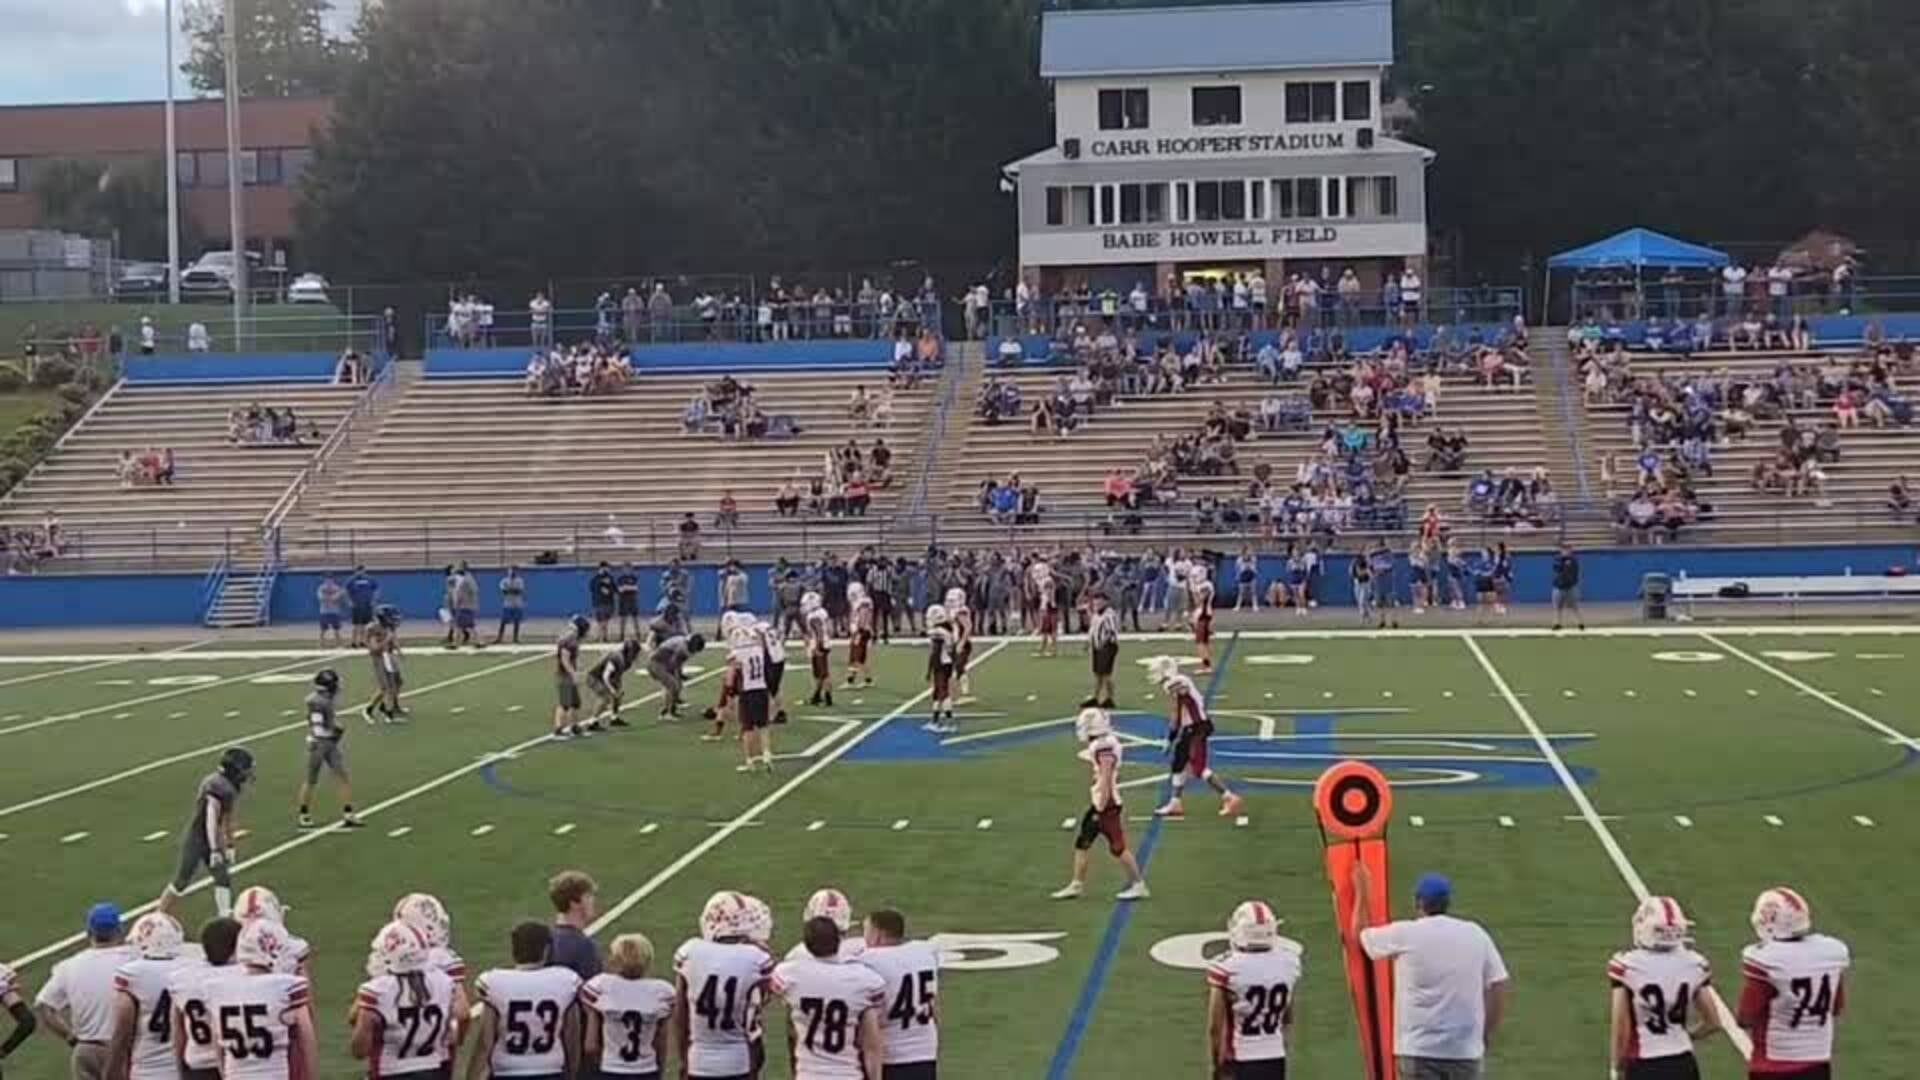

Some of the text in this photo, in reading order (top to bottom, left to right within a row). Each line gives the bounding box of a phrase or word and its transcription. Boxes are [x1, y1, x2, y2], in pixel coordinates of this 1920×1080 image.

[1091, 132, 1344, 157] CARR HOOPER STADIUM
[1102, 227, 1337, 249] BABE HOWELL FIELD
[749, 655, 762, 680] 11
[695, 974, 738, 1030] 41
[801, 997, 848, 1055] 78
[889, 970, 934, 1030] 45
[1240, 983, 1289, 1037] 28
[1639, 982, 1690, 1035] 34
[1790, 973, 1831, 1028] 74
[219, 1003, 273, 1059] 55
[397, 1005, 443, 1058] 72
[506, 1000, 558, 1055] 53
[619, 1010, 642, 1062] 3
